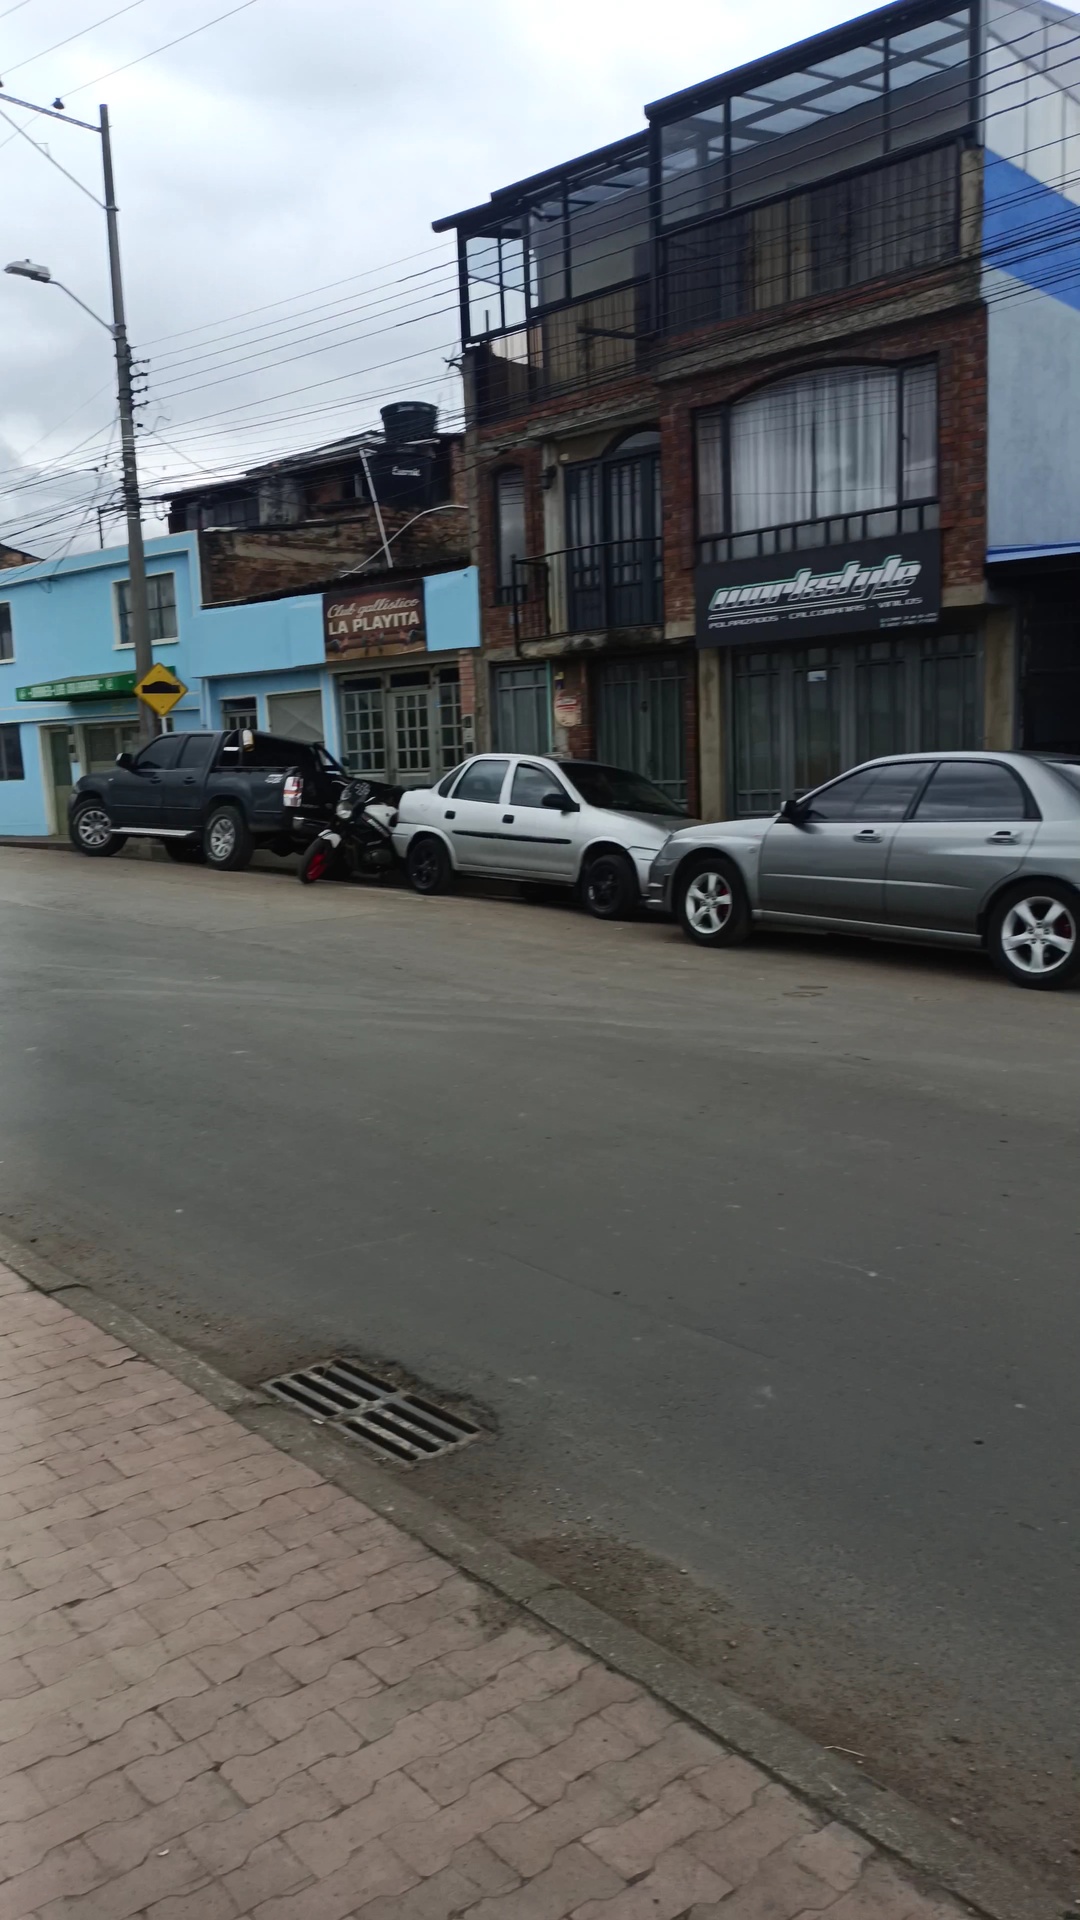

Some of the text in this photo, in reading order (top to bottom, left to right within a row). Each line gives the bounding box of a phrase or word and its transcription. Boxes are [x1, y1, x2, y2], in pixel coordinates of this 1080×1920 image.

[709, 554, 922, 612] workstyle
[327, 602, 356, 618] Club
[328, 610, 420, 635] LA PLAYITA
[708, 615, 780, 630] POLARIZADOS
[877, 597, 923, 609] VINILOS
